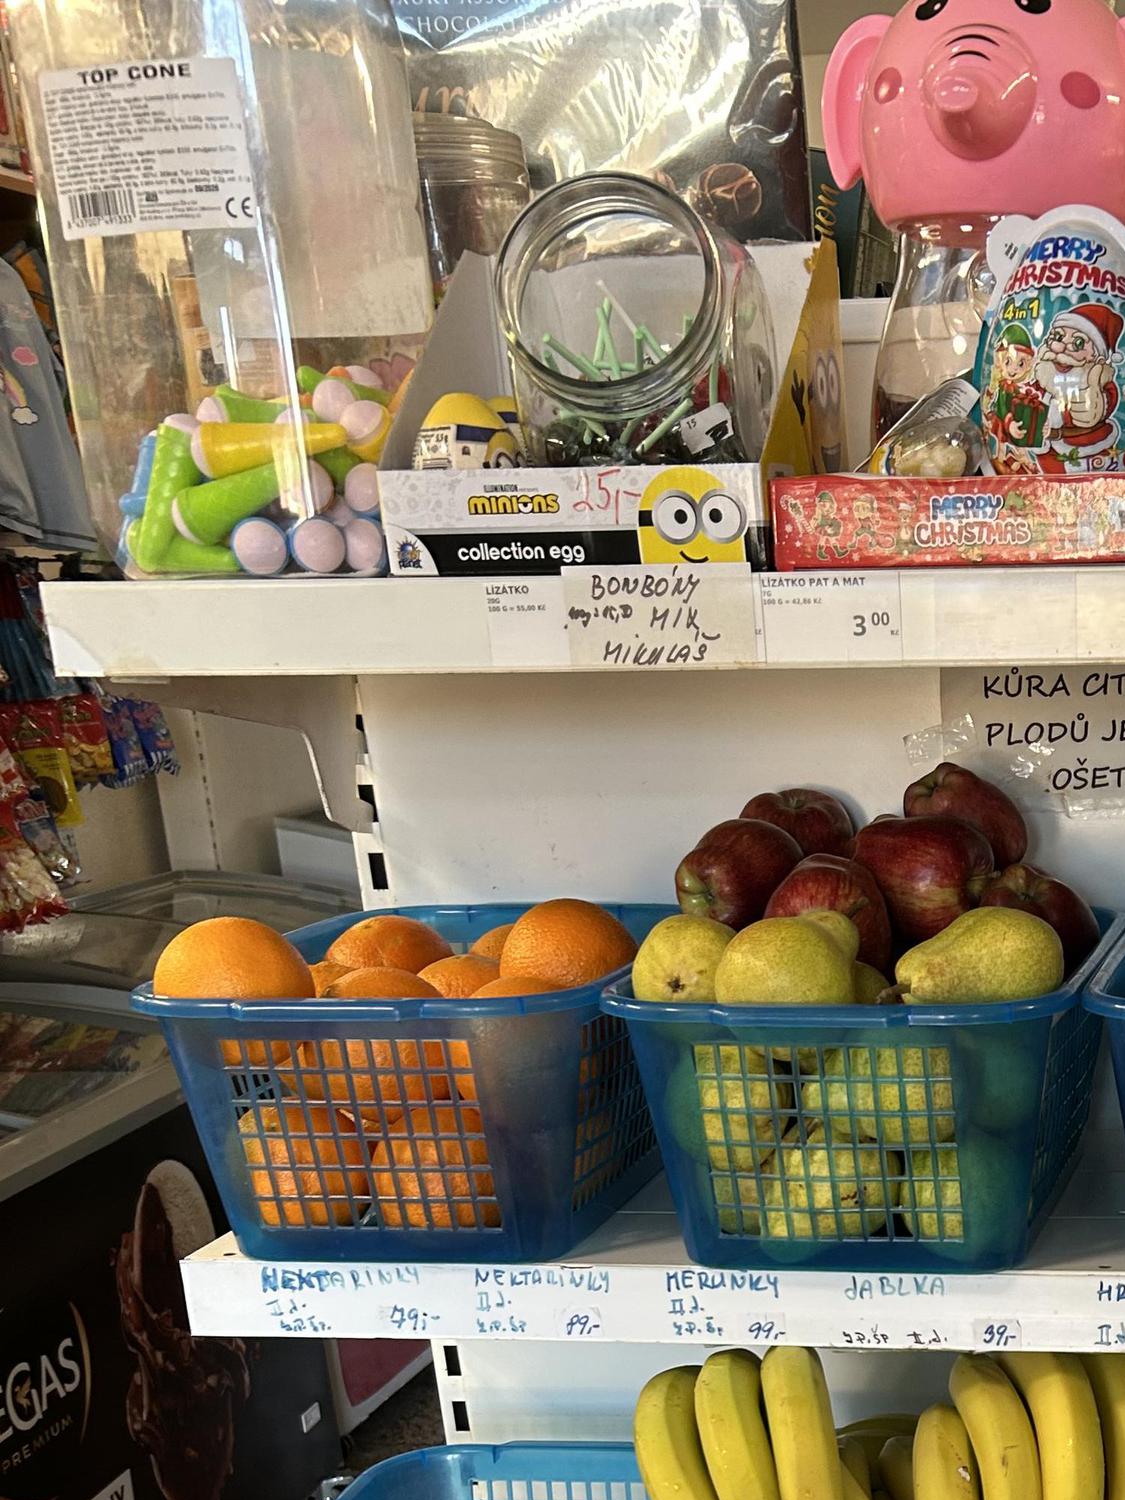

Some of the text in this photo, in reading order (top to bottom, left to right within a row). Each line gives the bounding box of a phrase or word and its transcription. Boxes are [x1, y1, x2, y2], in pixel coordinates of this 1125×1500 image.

[78, 62, 191, 86] TOP CONE
[1026, 236, 1106, 263] MERRY
[1003, 299, 1040, 320] 4 in 1
[929, 493, 1003, 522] MERRY
[914, 520, 1031, 547] CHRISTMAS
[457, 542, 585, 563] collection egg
[485, 584, 529, 595] LÍZÁTKO
[761, 576, 866, 588] LÍZÁTKO PAT A MAT
[852, 614, 867, 637] 3
[871, 611, 890, 626] 00
[984, 667, 1070, 698] KŮRA
[986, 713, 1089, 747] PLODŮ
[1, 1414, 75, 1474] PREMIUM
